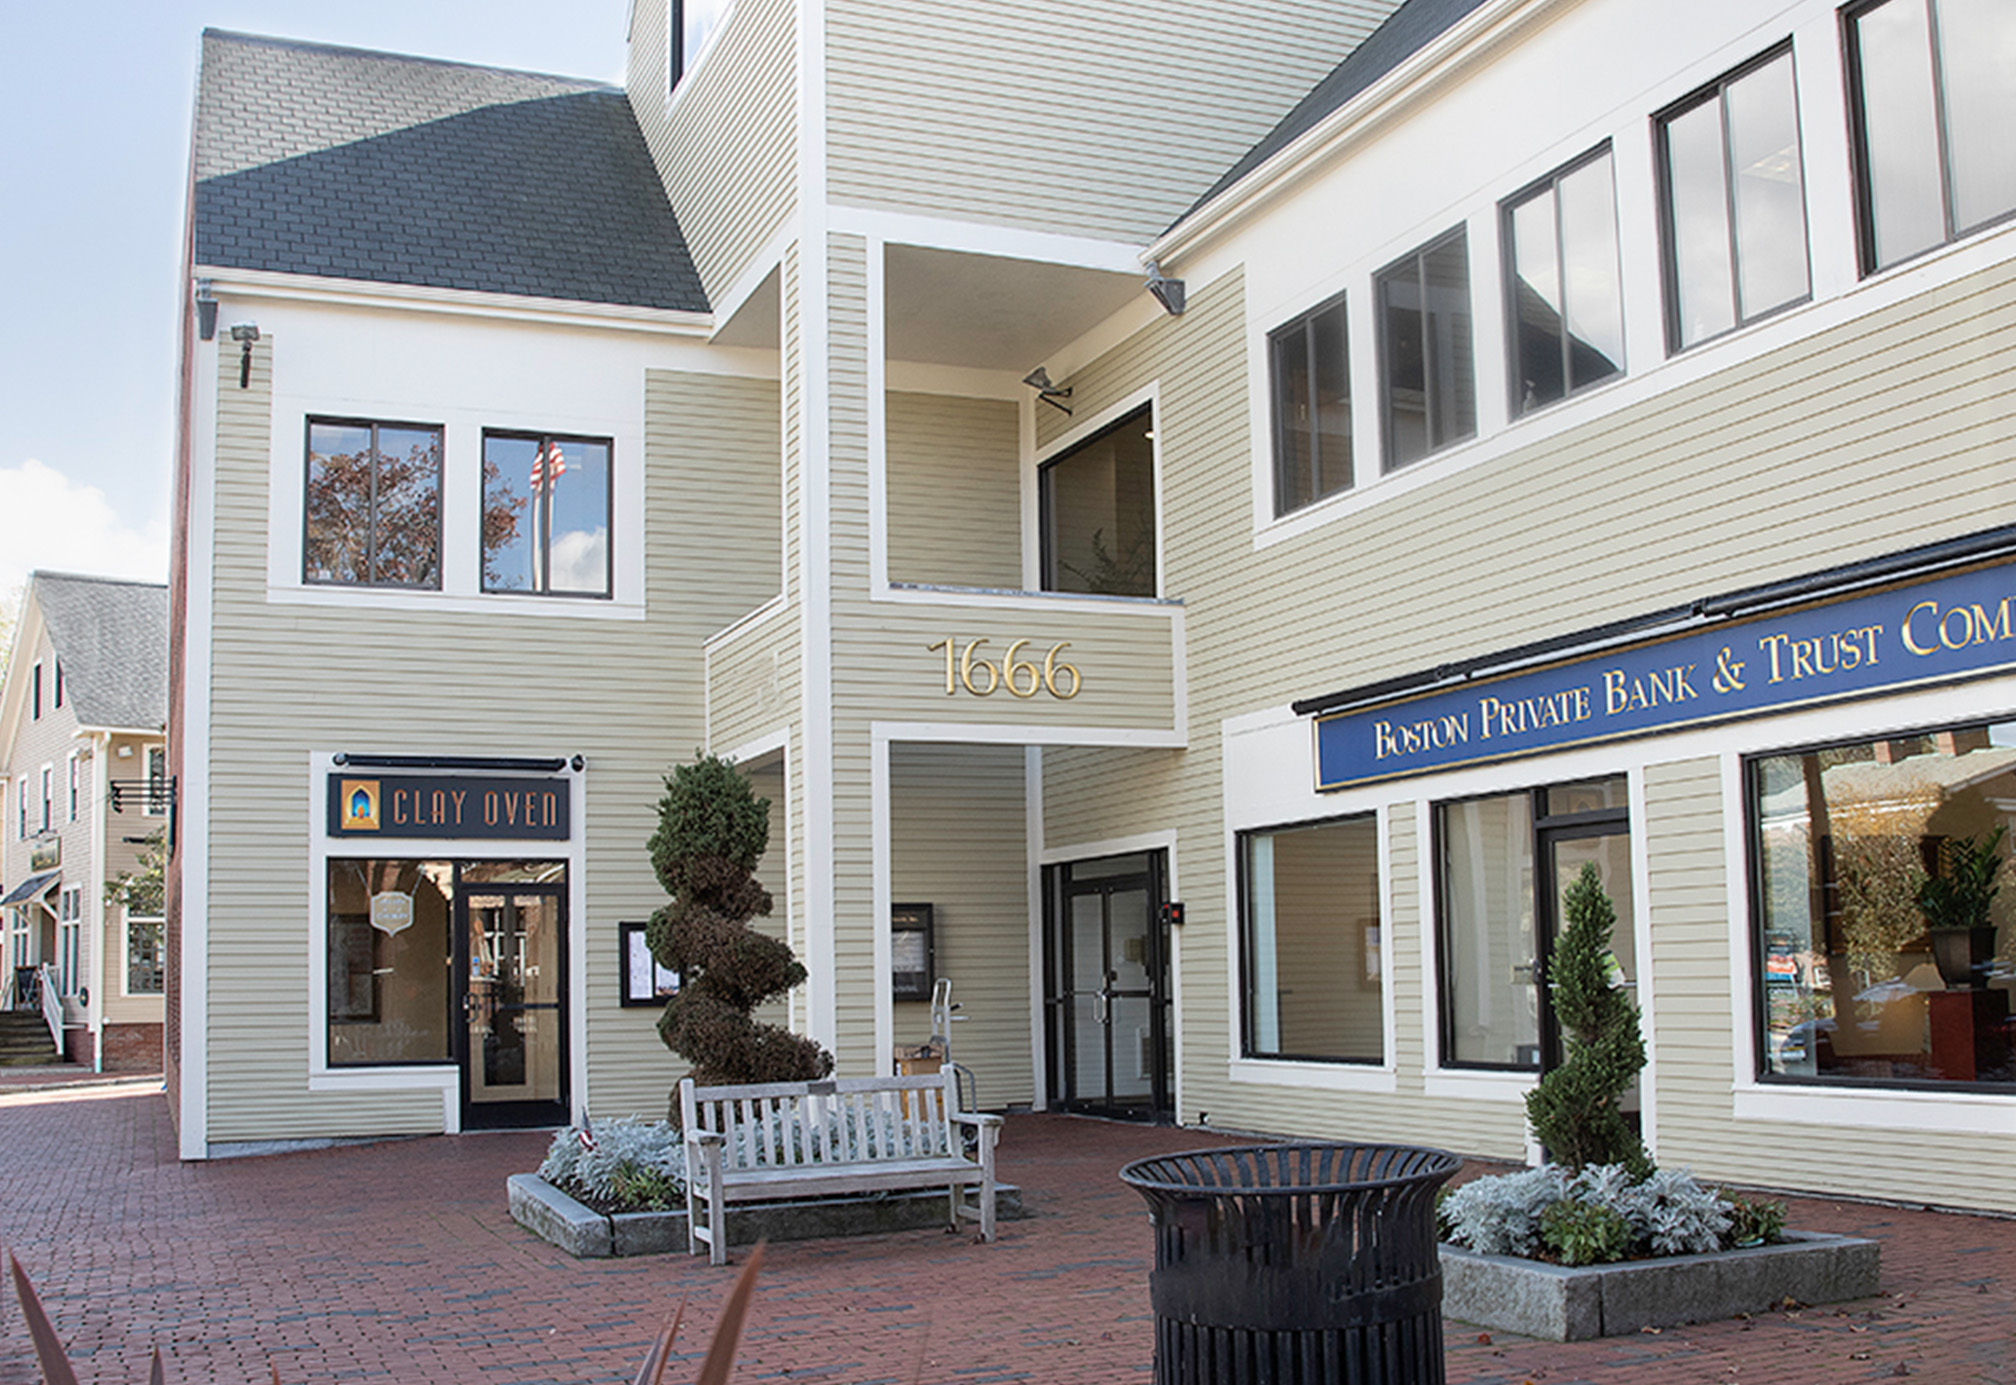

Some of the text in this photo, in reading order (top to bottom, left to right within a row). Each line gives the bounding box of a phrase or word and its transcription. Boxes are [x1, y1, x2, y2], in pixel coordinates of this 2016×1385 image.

[927, 636, 1083, 700] 1666
[1374, 596, 2016, 760] BOSTON PRIVATE BANK & TRUST COM
[393, 788, 557, 827] CLAY OVEN
